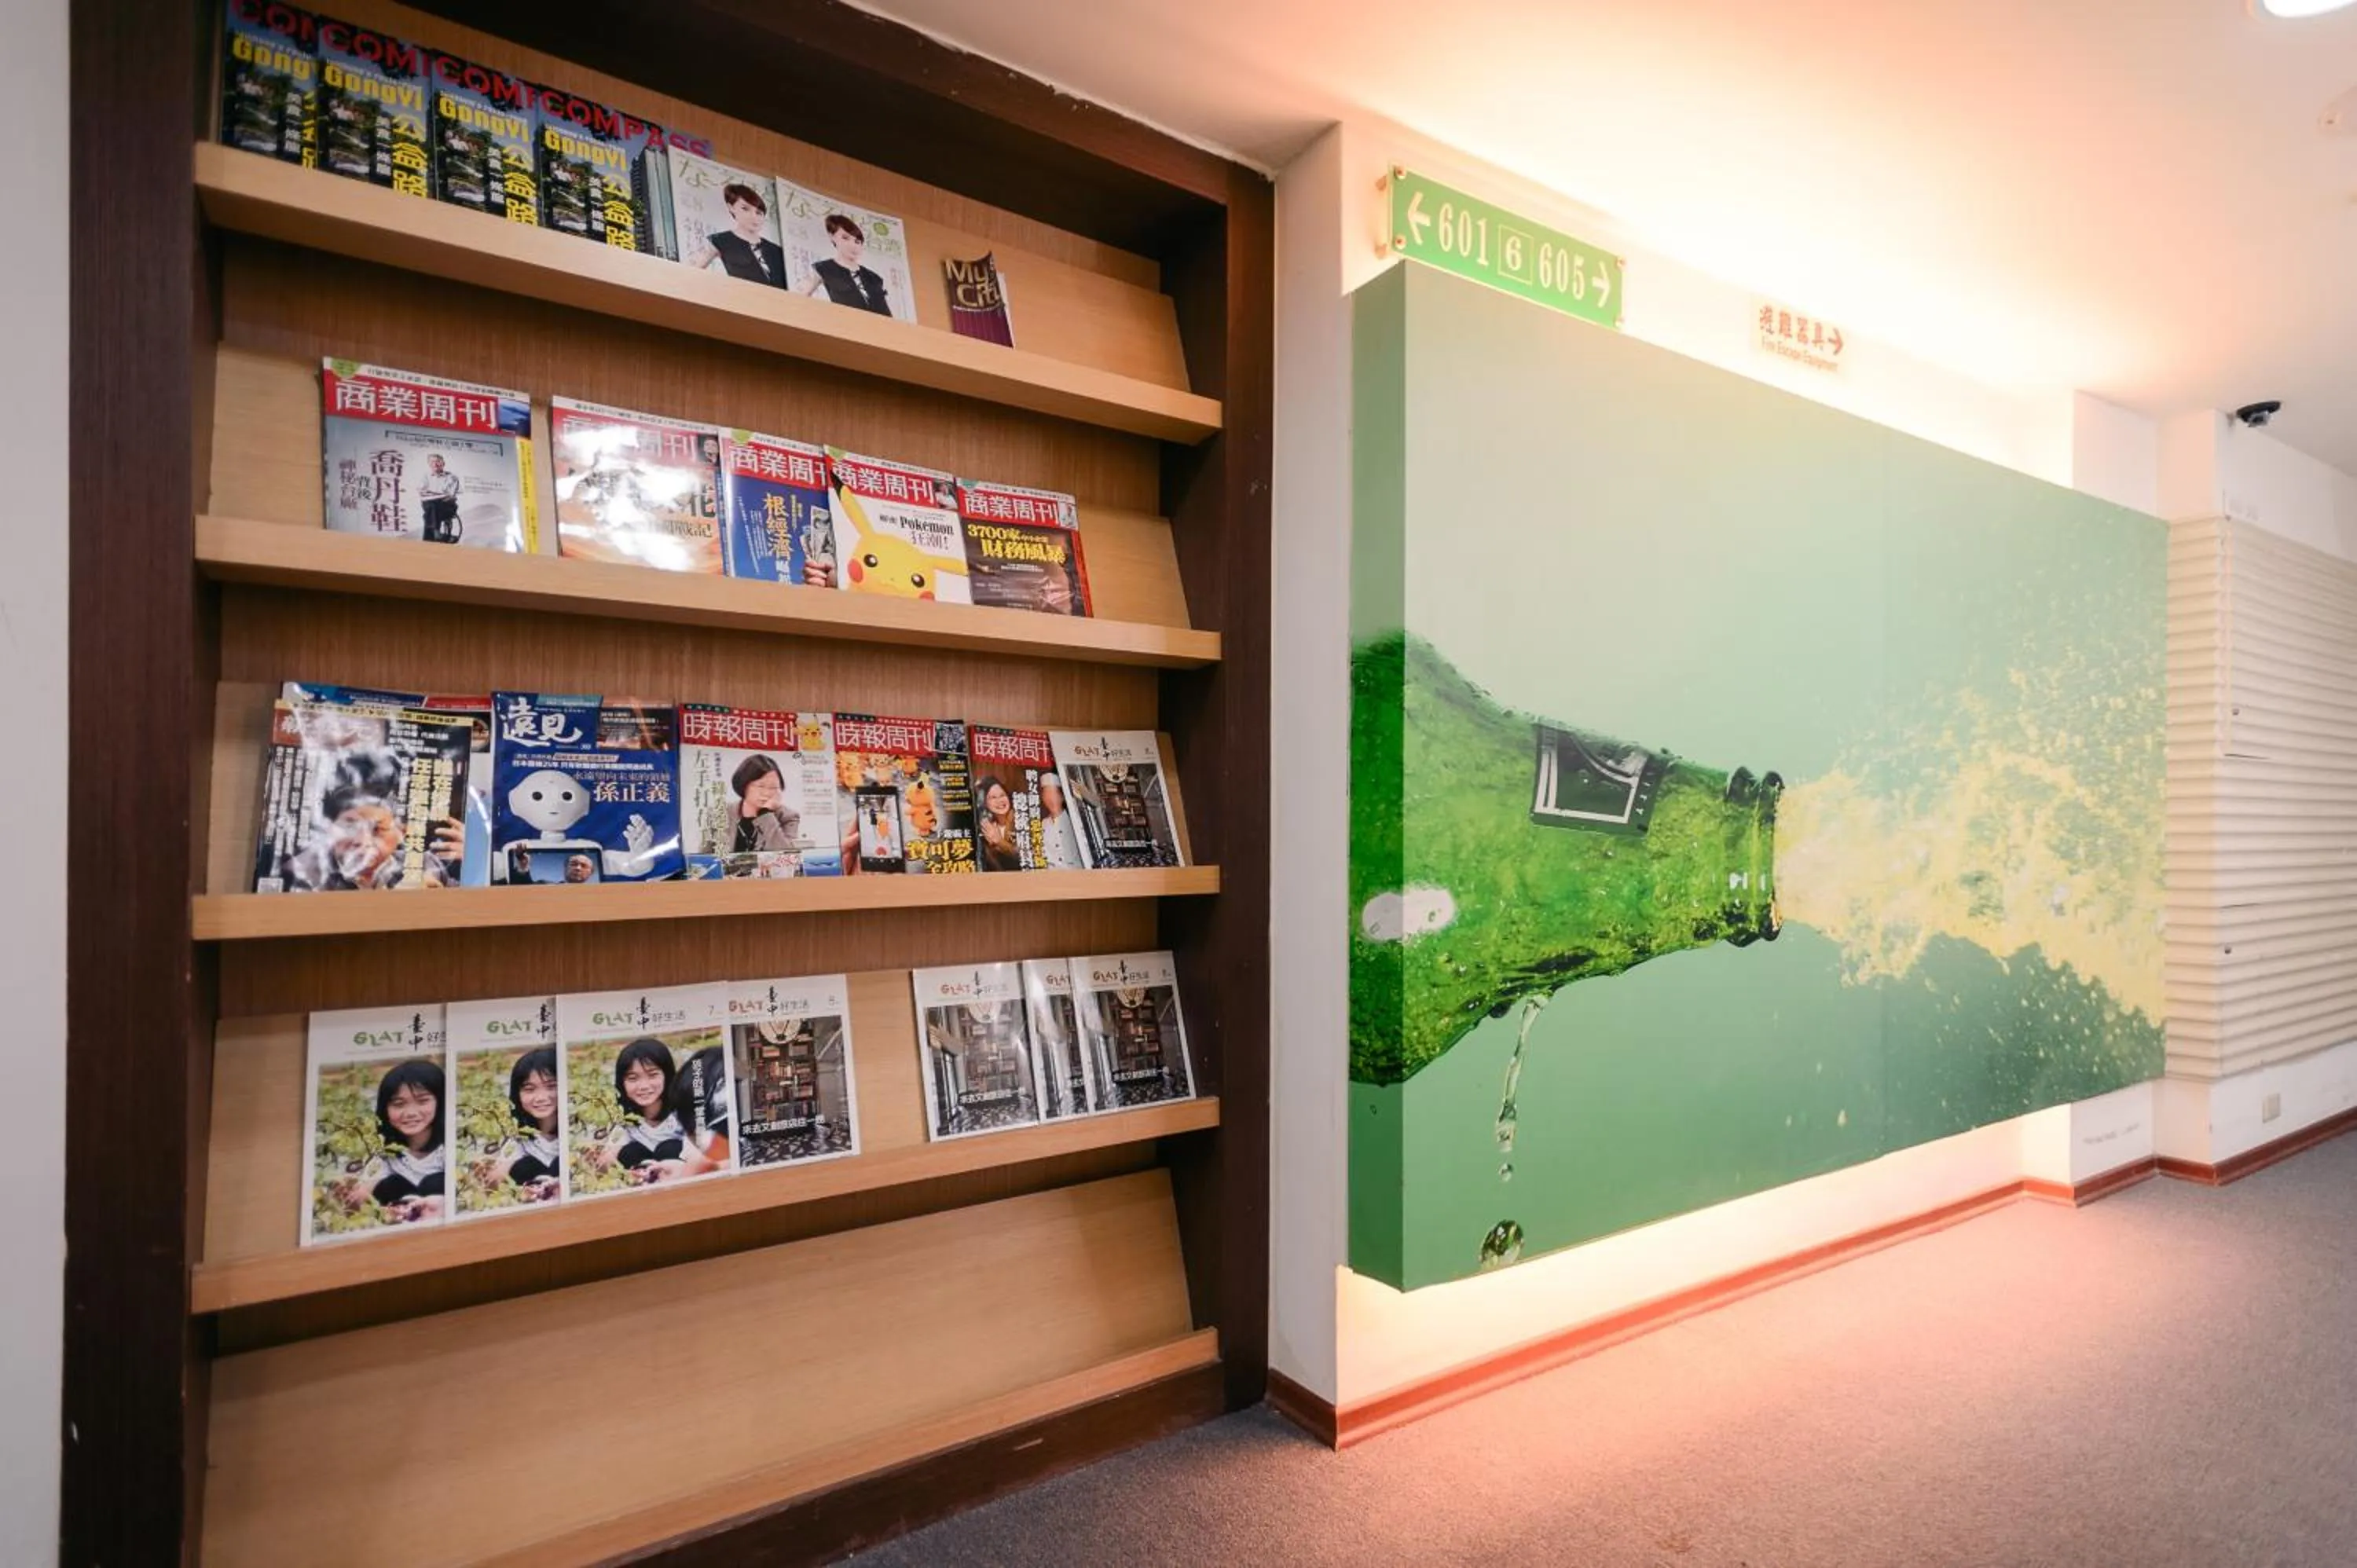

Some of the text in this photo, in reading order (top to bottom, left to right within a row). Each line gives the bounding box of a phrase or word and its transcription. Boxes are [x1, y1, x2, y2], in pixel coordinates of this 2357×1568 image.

[1439, 202, 1585, 301] 601 6 605
[335, 380, 497, 430] 商業周刊
[833, 462, 934, 504] 商業周刊
[965, 492, 1060, 525] 商業周刊
[500, 696, 583, 747] 遠見
[683, 712, 794, 746] 時報周刊
[835, 721, 933, 753] 時報周刊
[593, 782, 670, 802] 孫正義
